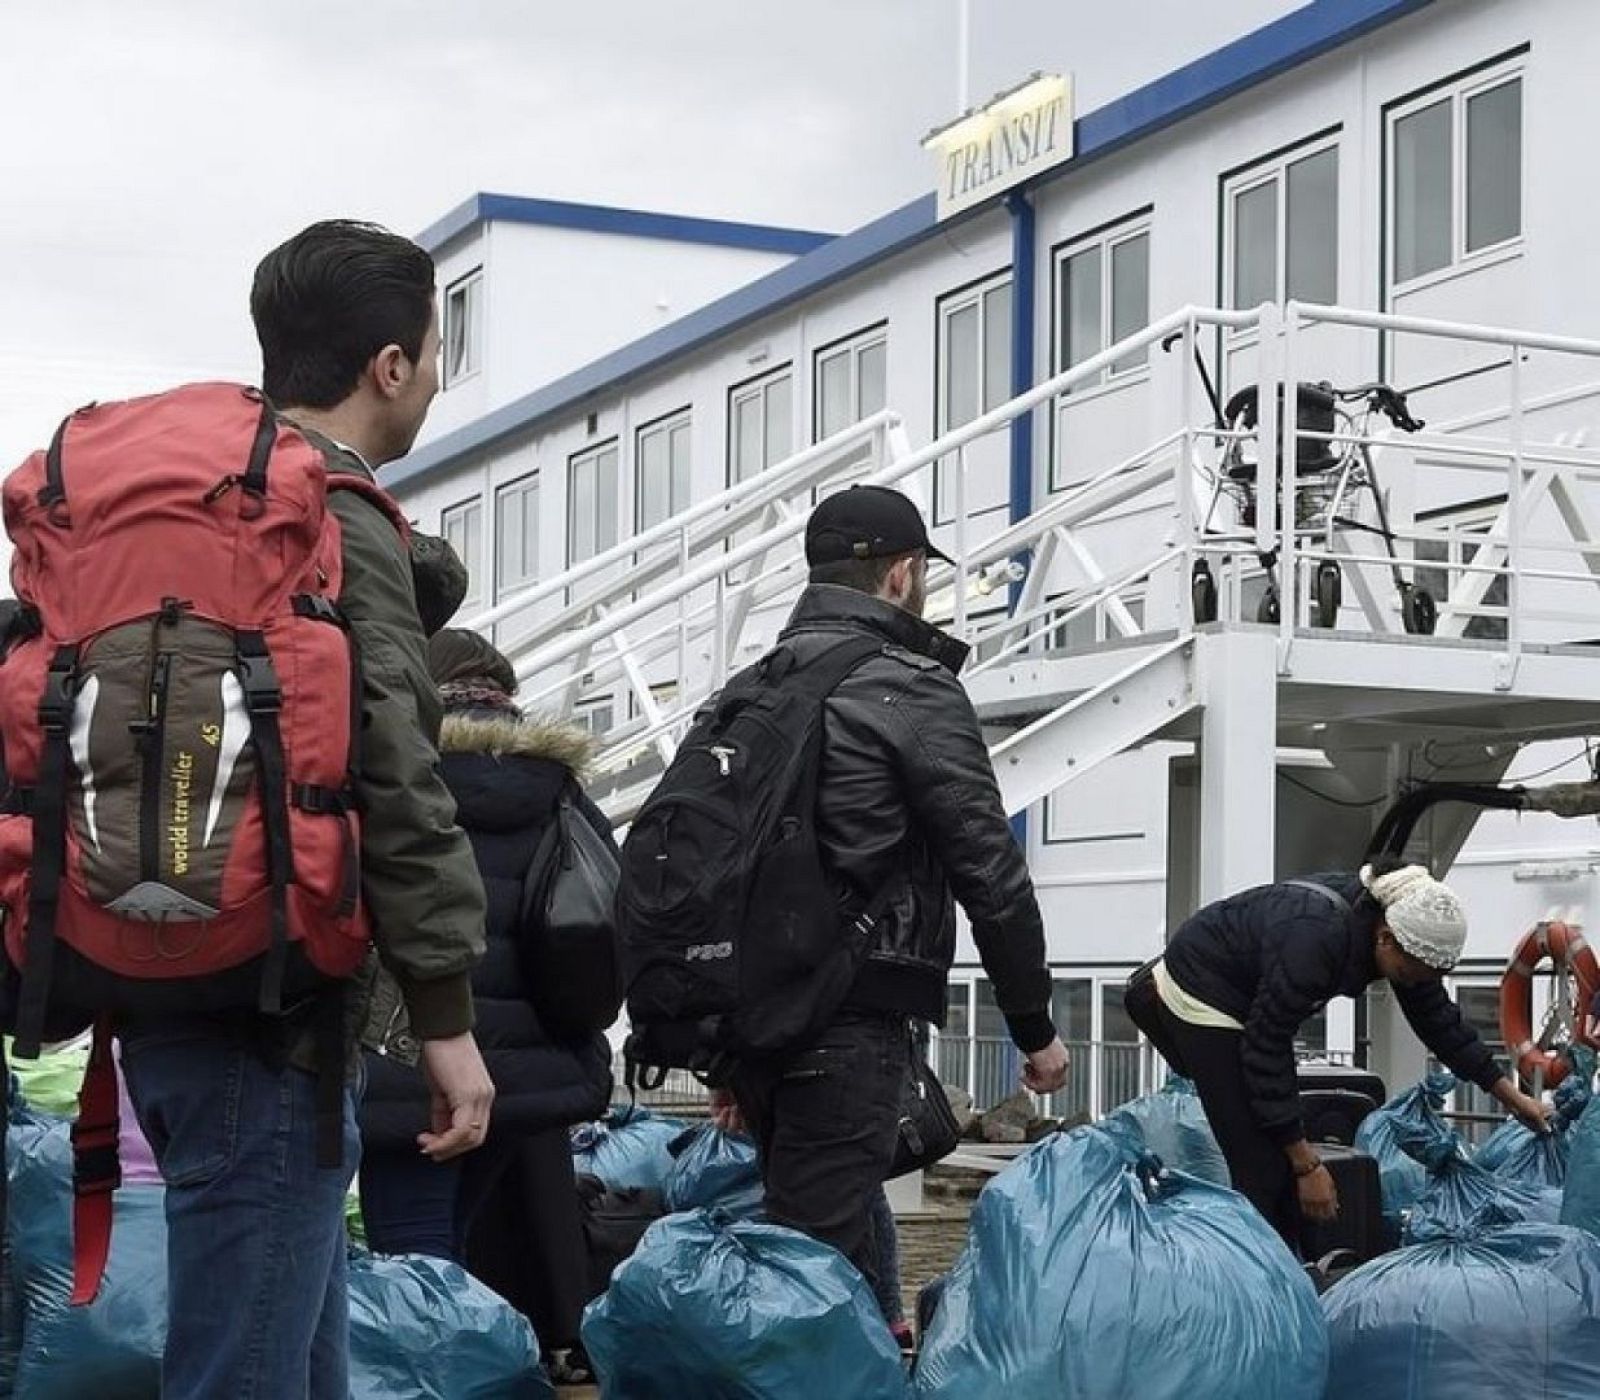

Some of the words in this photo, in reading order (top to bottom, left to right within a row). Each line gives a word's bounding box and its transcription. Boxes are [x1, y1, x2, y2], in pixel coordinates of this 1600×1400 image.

[947, 97, 1063, 200] TRANSIT
[202, 722, 220, 747] 45
[171, 751, 192, 823] traveller
[168, 825, 189, 875] world
